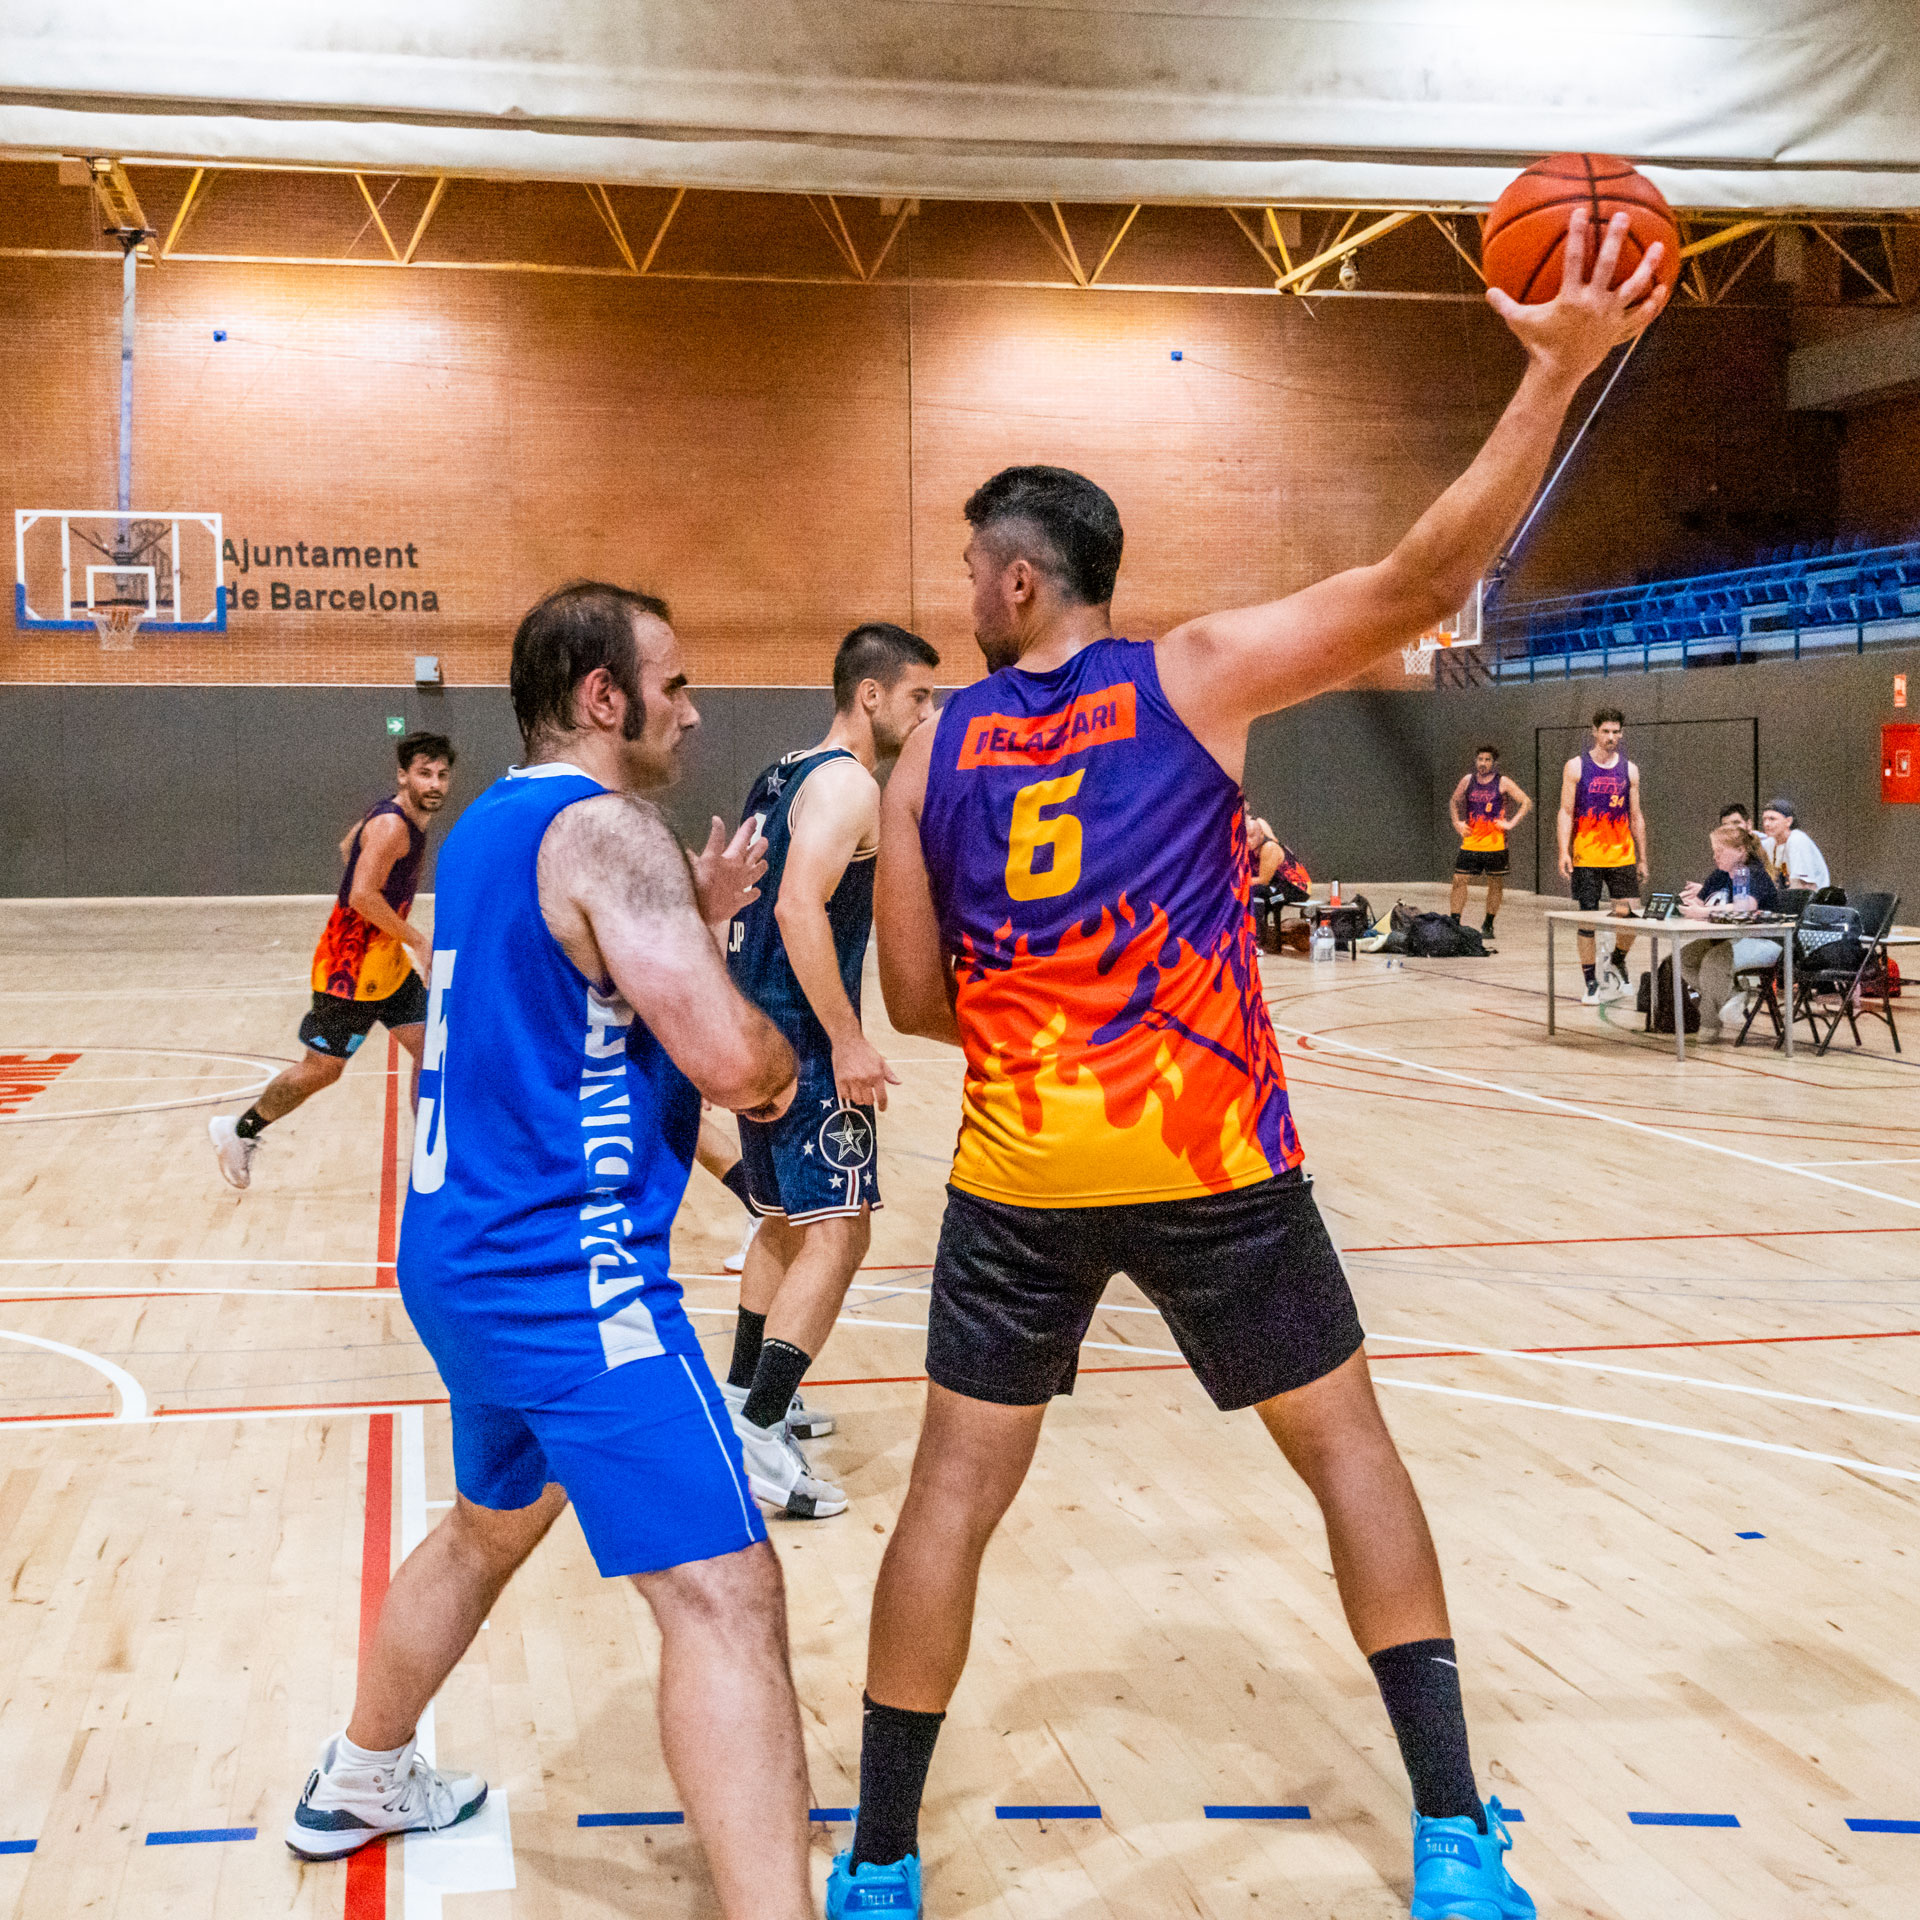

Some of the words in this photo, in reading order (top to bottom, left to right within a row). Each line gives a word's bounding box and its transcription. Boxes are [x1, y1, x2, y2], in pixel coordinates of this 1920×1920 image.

[222, 538, 419, 573] Ajuntament
[225, 581, 260, 610] de
[270, 582, 440, 612] Barcelona
[1608, 795, 1625, 808] 34
[1005, 768, 1086, 902] 6
